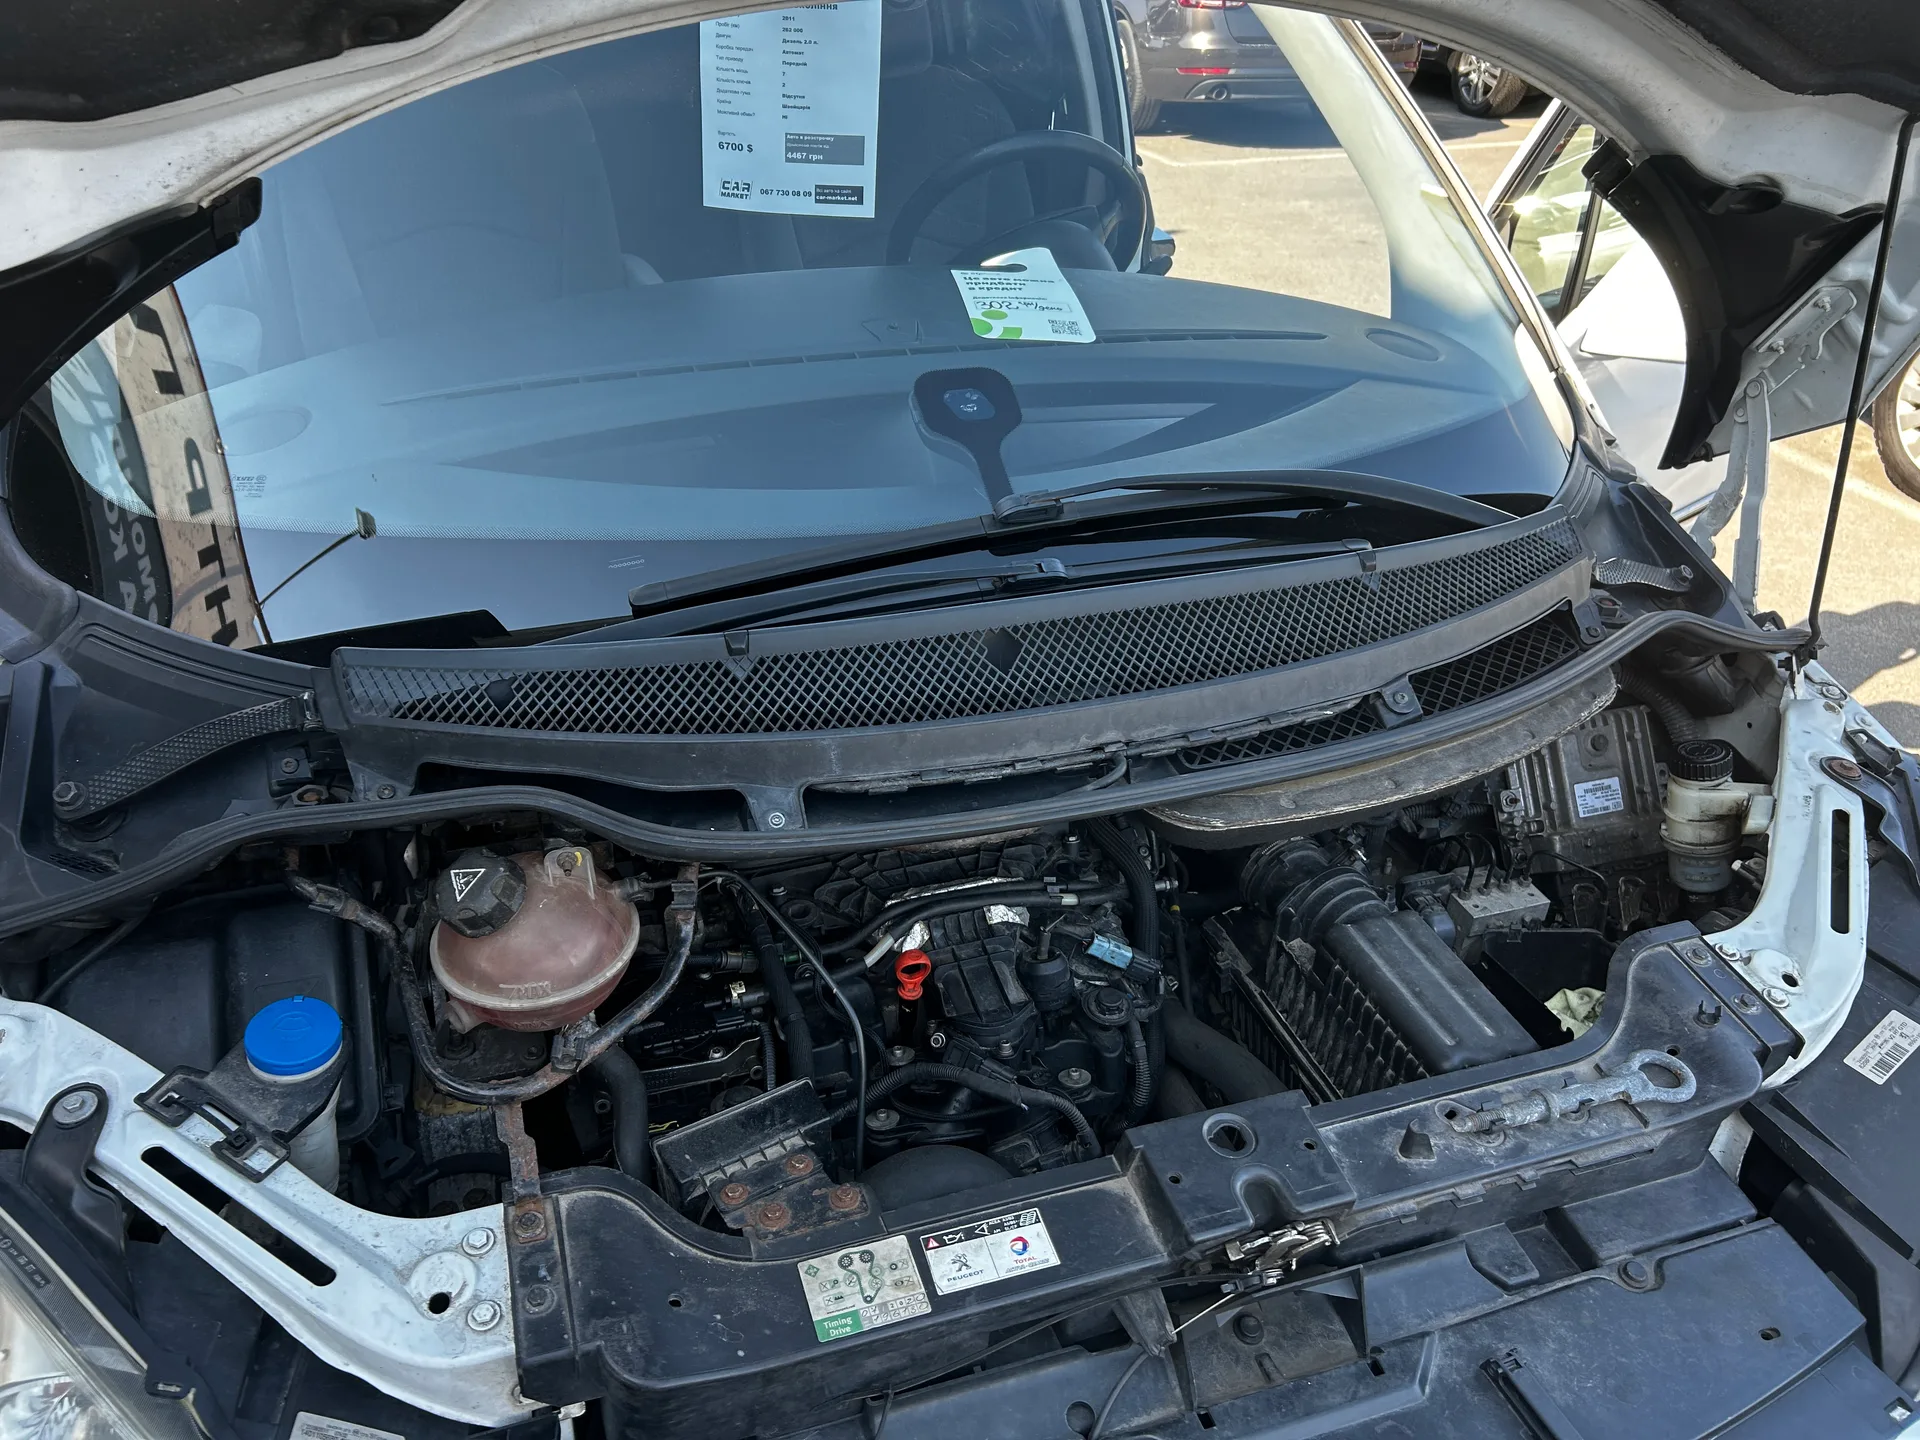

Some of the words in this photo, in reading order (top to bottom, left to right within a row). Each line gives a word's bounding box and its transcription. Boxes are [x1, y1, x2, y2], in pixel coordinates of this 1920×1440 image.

[718, 141, 744, 152] 6700
[747, 144, 753, 153] $
[722, 180, 750, 192] CAR
[947, 1269, 984, 1282] PEUGEOT
[823, 1316, 853, 1329] Timing
[829, 1326, 851, 1336] Drive
